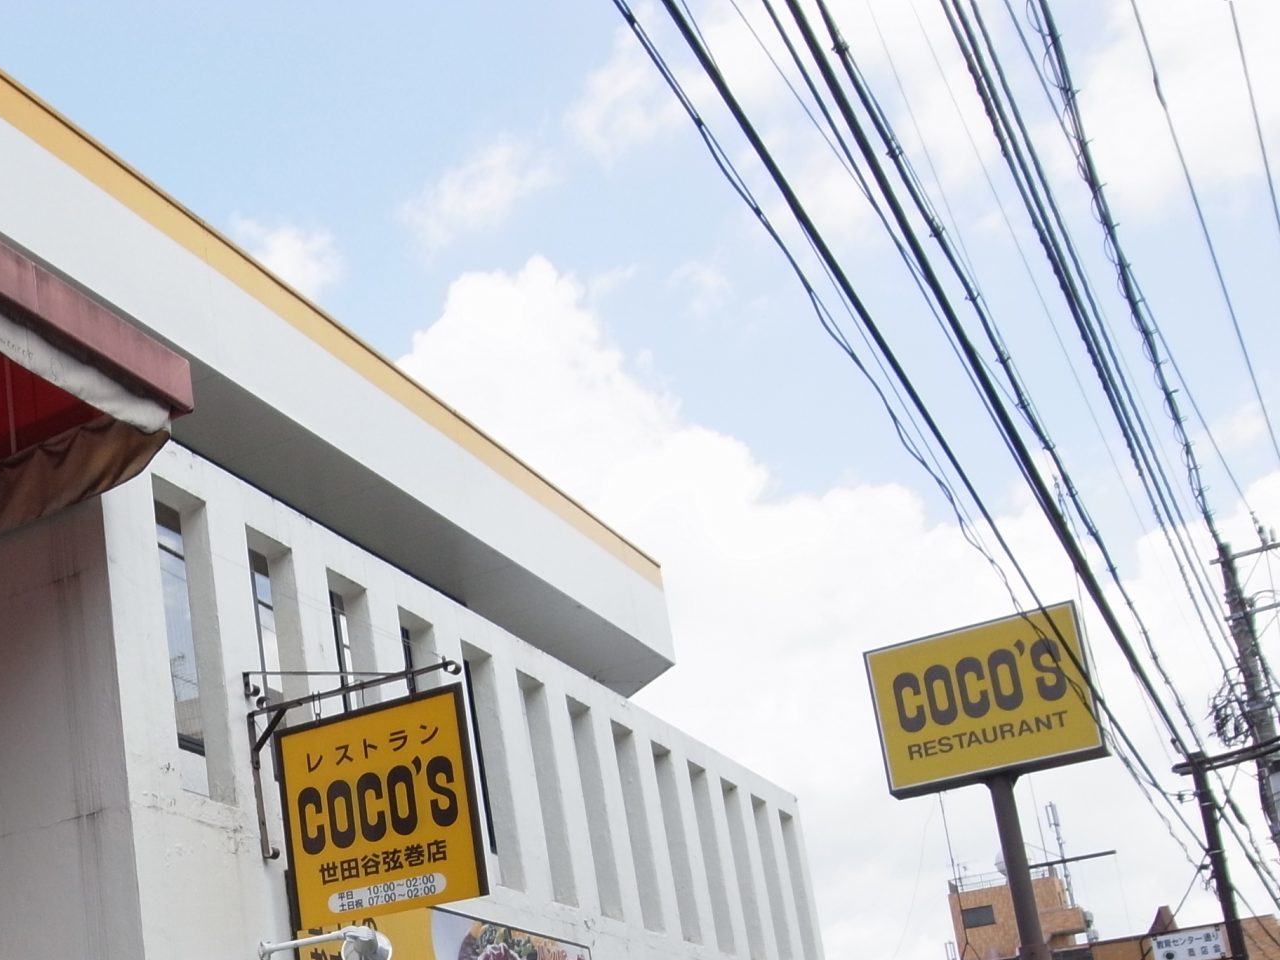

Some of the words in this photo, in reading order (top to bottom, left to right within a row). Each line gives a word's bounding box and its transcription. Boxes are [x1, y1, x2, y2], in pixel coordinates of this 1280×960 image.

[892, 638, 1068, 734] COCO'S
[305, 723, 441, 774] レストラン
[907, 710, 1069, 762] RESTAURANT
[297, 755, 459, 856] COCO'S
[319, 839, 448, 886] 世田谷弦巻店
[338, 890, 354, 902] 平日
[338, 898, 364, 913] 土日祝
